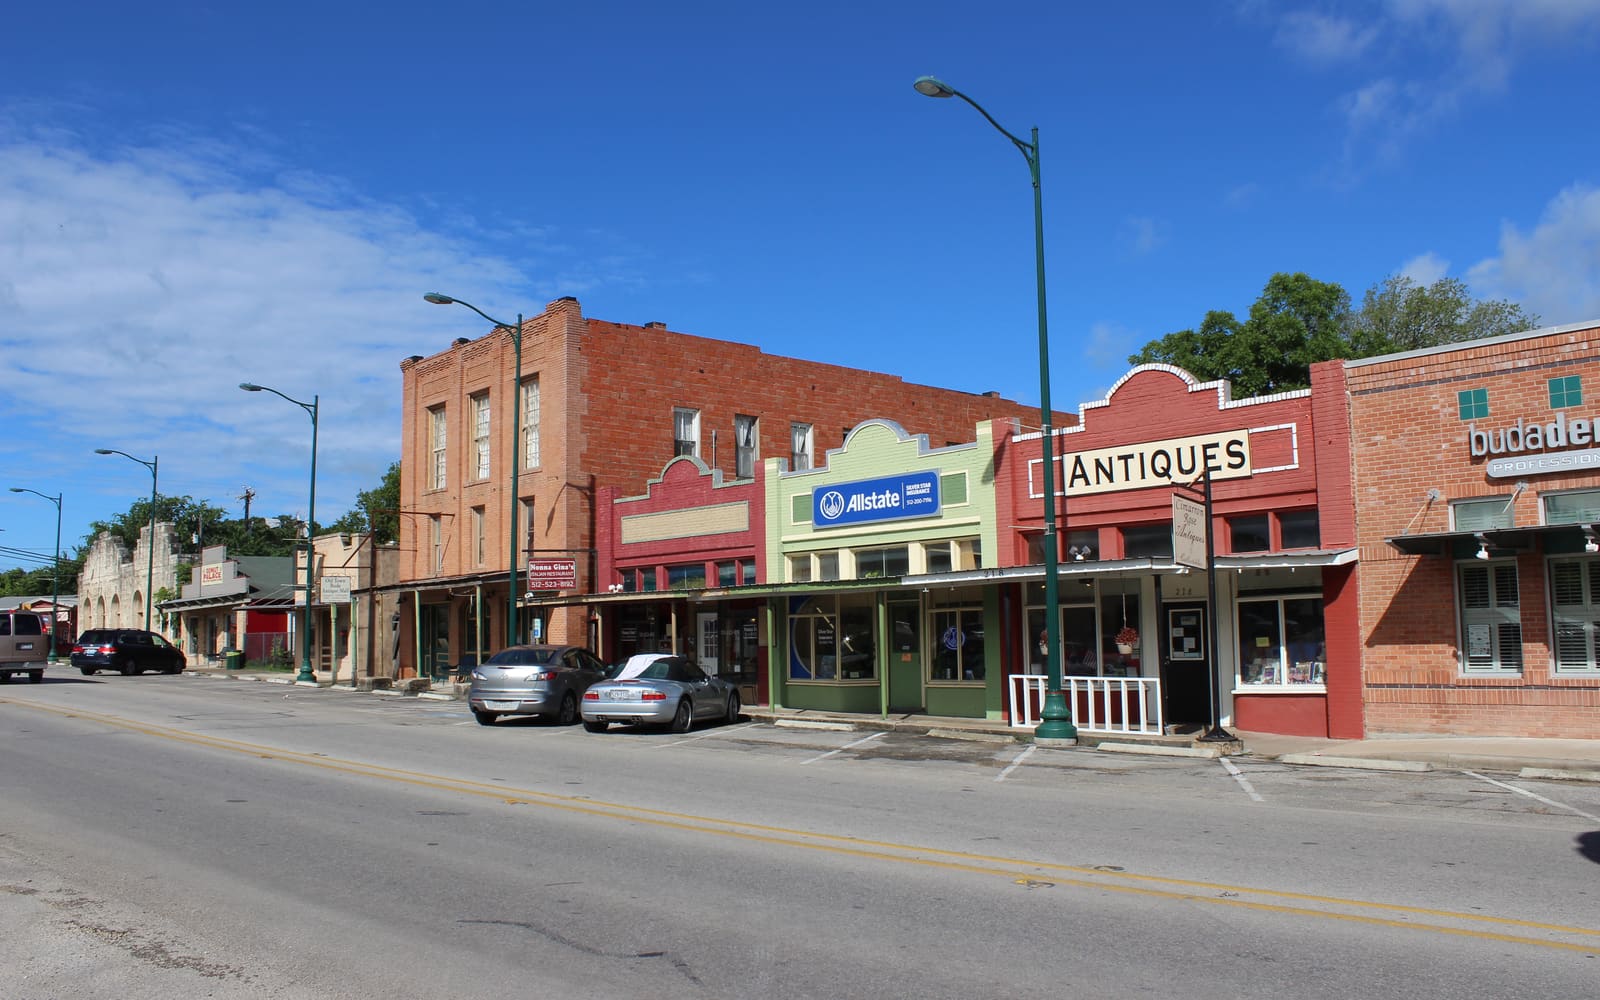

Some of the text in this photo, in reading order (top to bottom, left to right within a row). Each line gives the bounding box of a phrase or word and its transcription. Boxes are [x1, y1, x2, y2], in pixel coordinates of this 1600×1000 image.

[1068, 439, 1247, 489] ANTIQUES
[846, 489, 900, 513] Allstate
[1175, 500, 1204, 515] Cimarron
[553, 563, 574, 571] Gina's
[203, 571, 222, 580] PALACE
